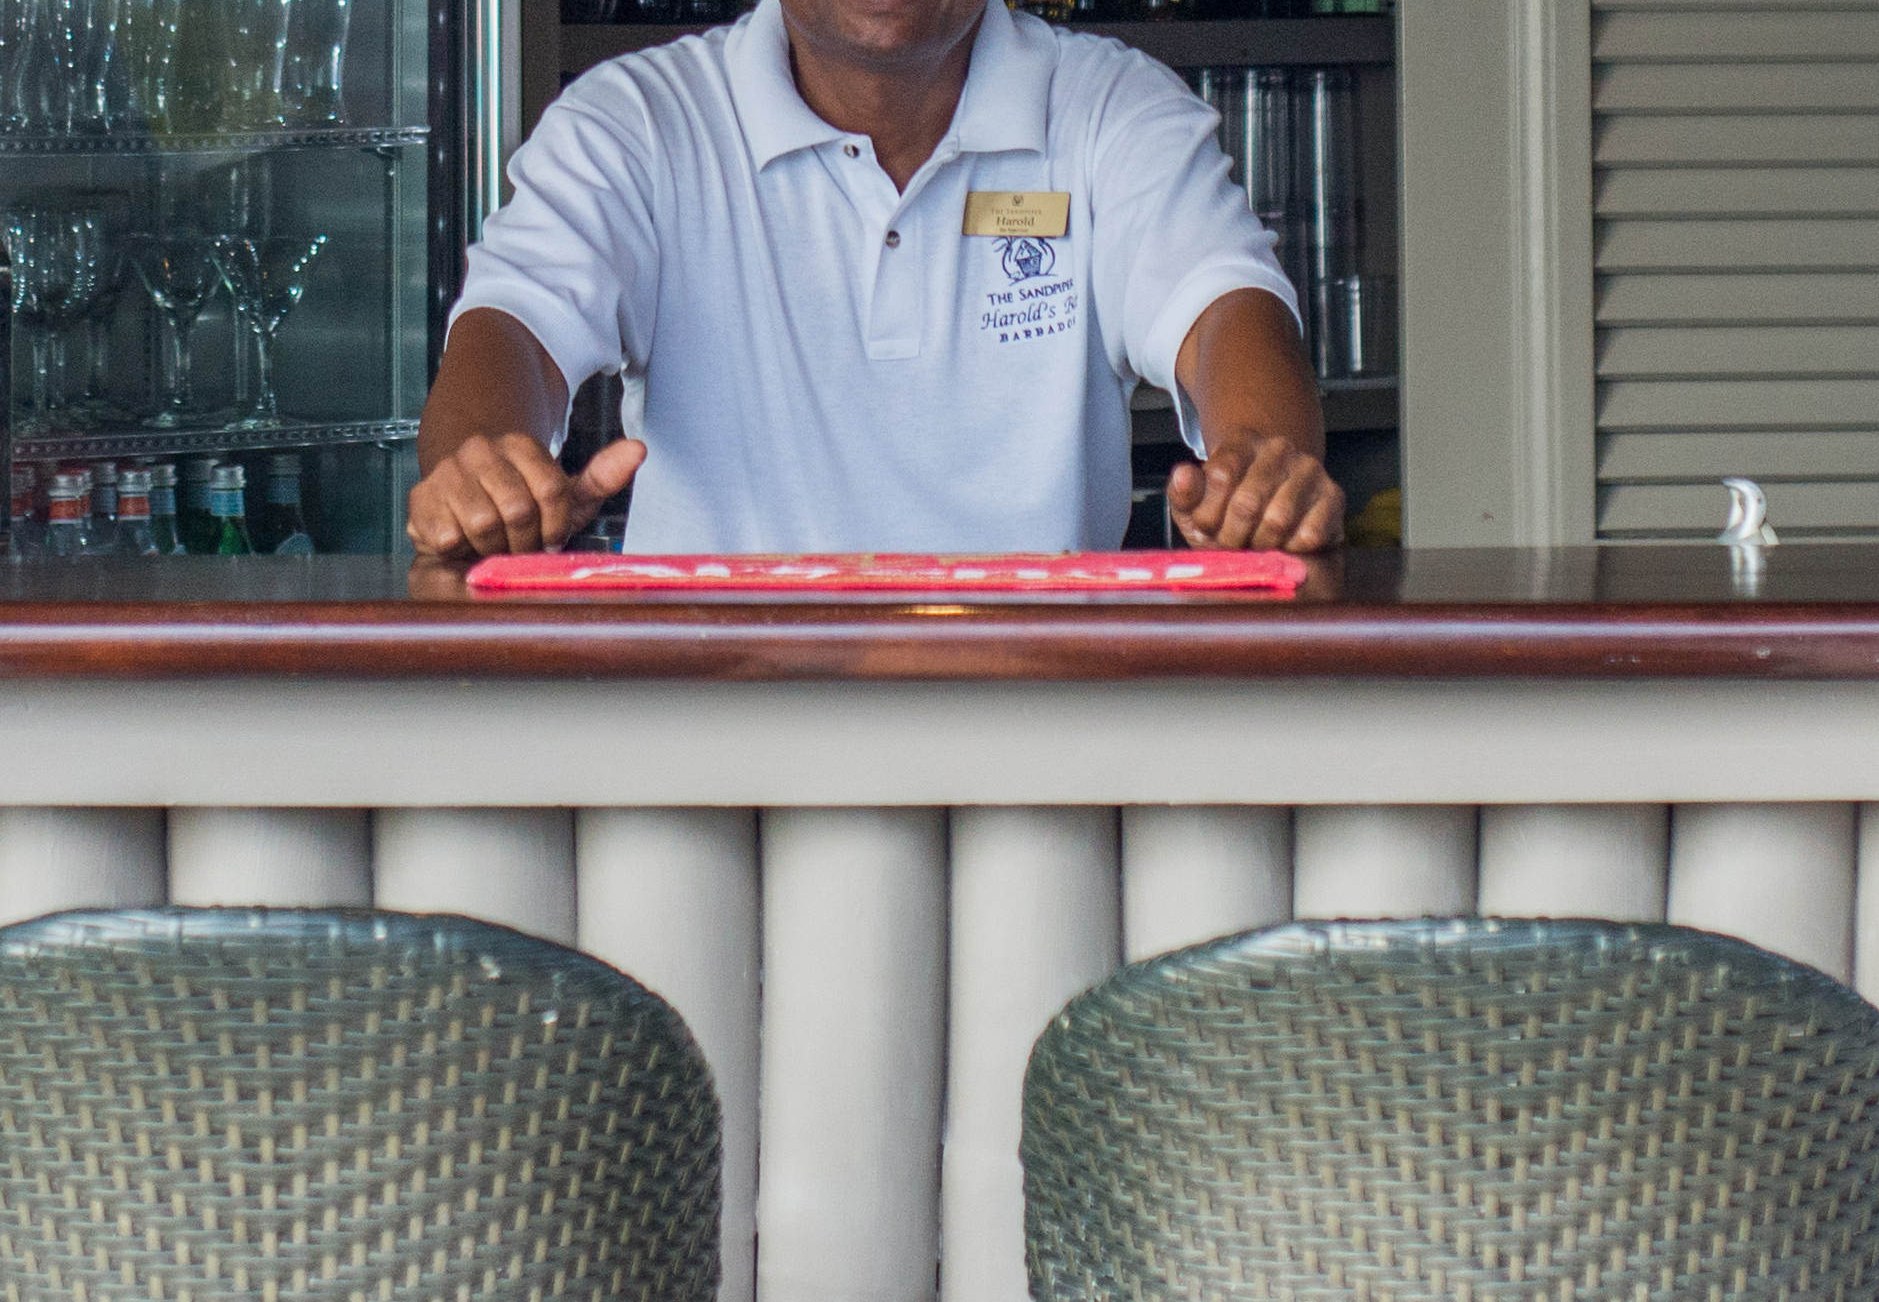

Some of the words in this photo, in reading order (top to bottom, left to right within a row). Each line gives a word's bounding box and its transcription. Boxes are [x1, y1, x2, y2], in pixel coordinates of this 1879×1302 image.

[995, 216, 1036, 228] Harold
[986, 292, 1014, 306] THE
[980, 301, 1057, 330] Harold's
